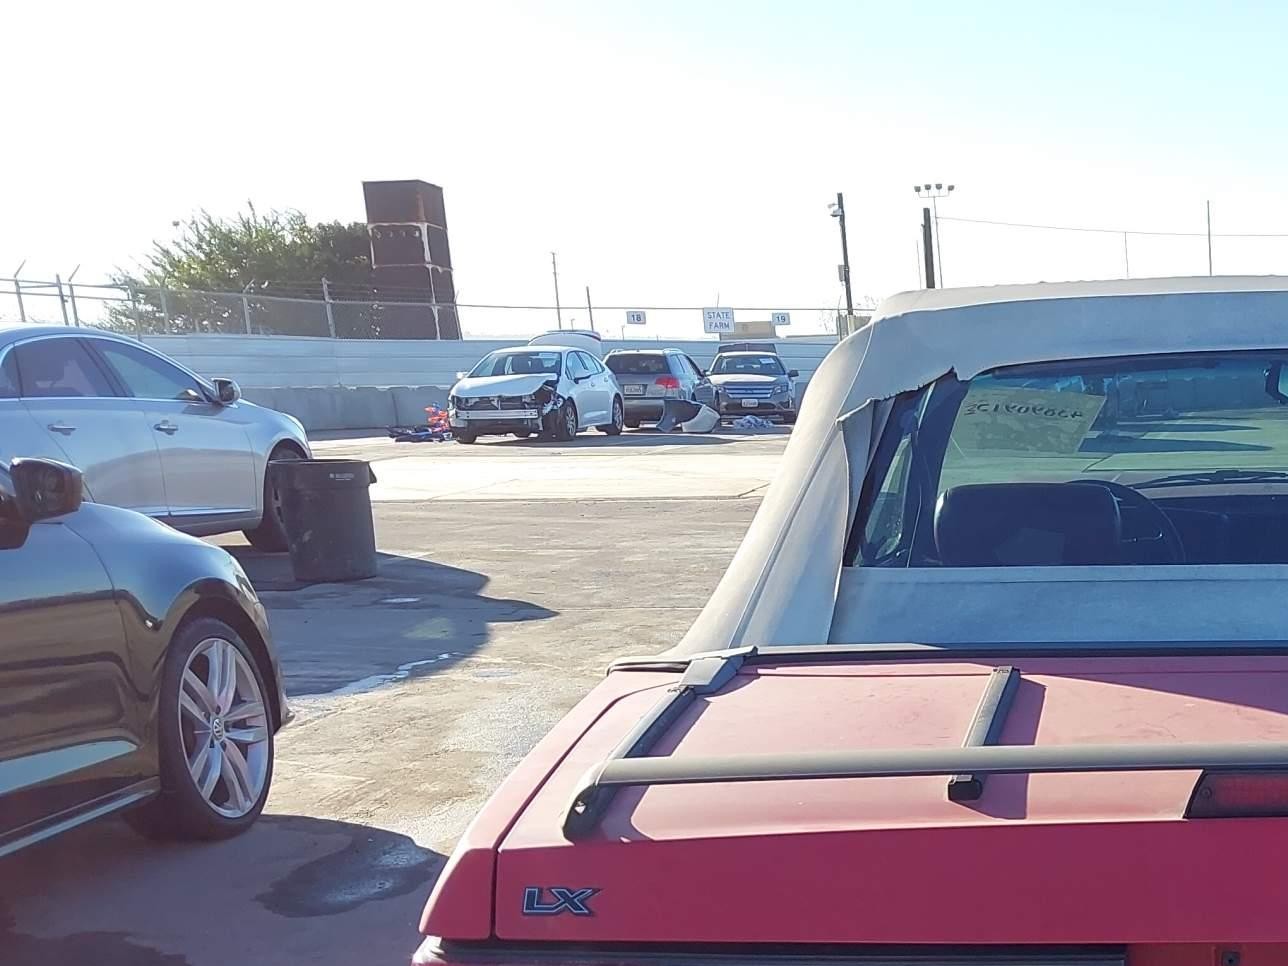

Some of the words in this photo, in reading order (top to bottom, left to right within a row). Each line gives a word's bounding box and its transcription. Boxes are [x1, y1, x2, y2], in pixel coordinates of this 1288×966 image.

[631, 314, 642, 322] 18
[707, 311, 730, 319] STATE
[776, 315, 785, 323] 19
[709, 321, 730, 330] FARM
[523, 887, 594, 913] LX
